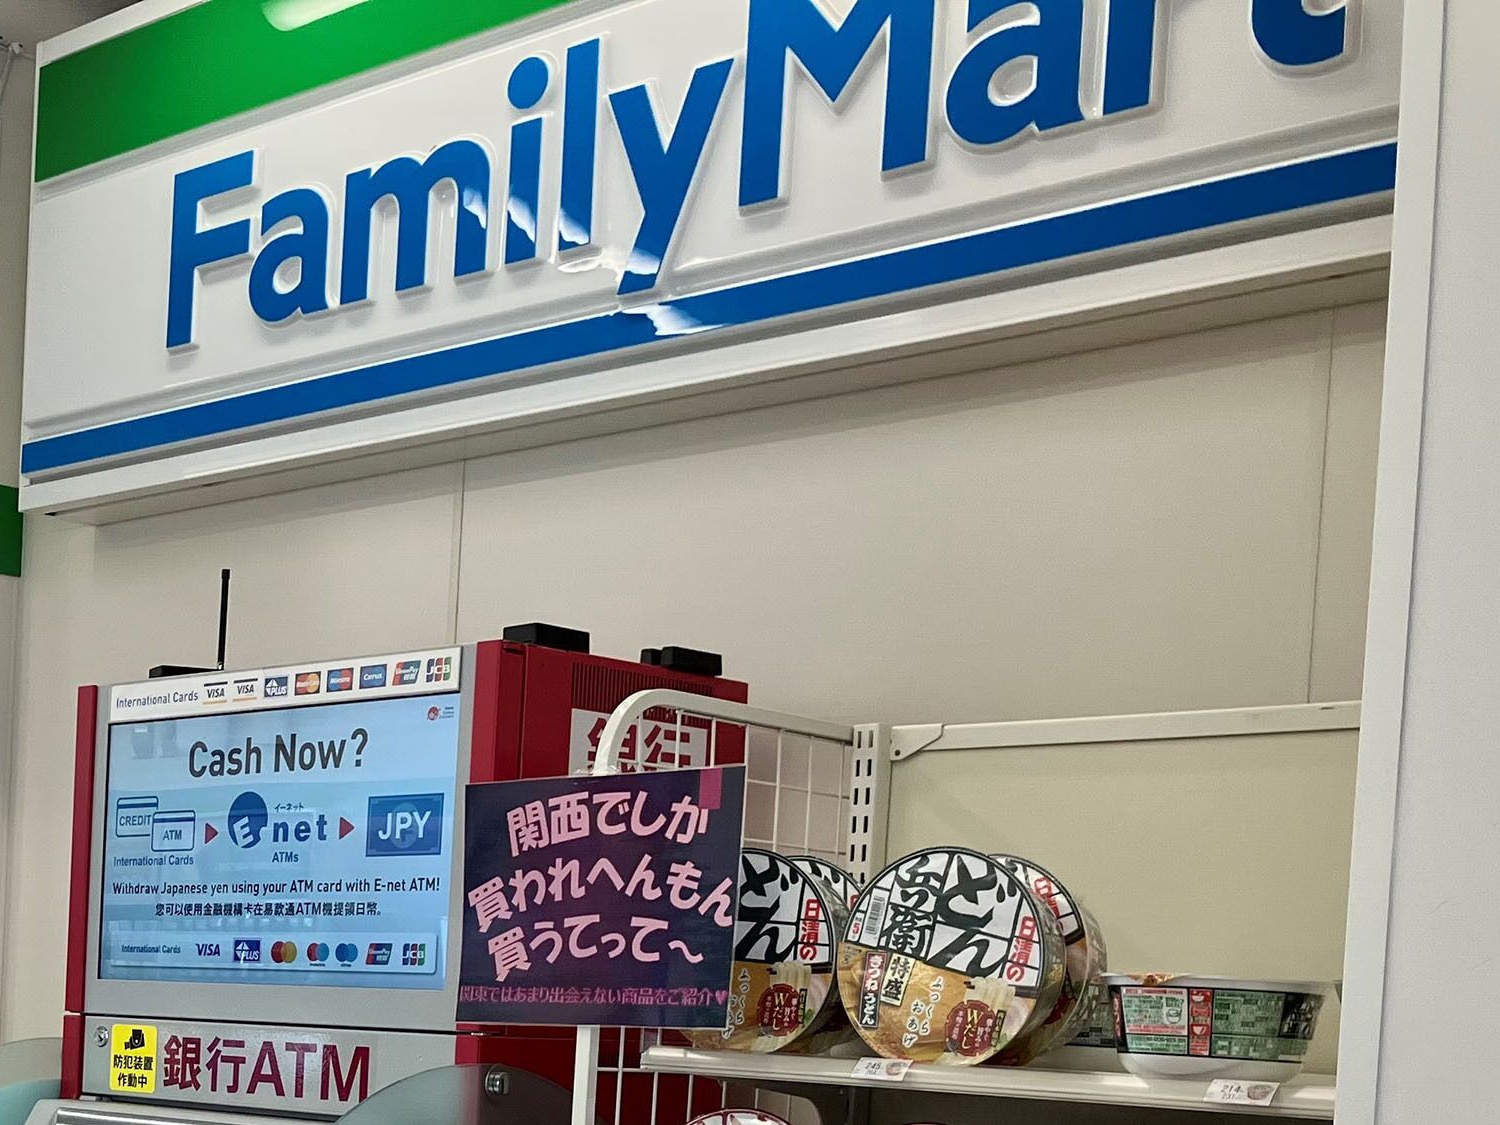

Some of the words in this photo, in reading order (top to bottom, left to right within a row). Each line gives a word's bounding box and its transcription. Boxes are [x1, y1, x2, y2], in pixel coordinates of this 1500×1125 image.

[166, 0, 1346, 350] FamilyMar
[116, 692, 170, 709] International
[173, 690, 199, 704] Cards
[206, 686, 225, 699] VISA
[237, 684, 255, 696] VISA
[271, 685, 288, 697] PLUS
[363, 672, 383, 681] Cirrus
[426, 662, 451, 677] JCB
[188, 737, 262, 778] Cash
[274, 727, 369, 773] Now?
[119, 814, 151, 827] CREDIT
[273, 814, 327, 843] net
[378, 810, 431, 841] JPY
[162, 828, 183, 842] ATM
[507, 791, 708, 857] 関西でしか
[113, 854, 168, 867] International
[169, 853, 194, 866] Cards
[272, 851, 299, 863] ATMs
[113, 881, 159, 896] Withdraw
[161, 881, 209, 897] Japanese
[211, 884, 229, 897] yen
[231, 880, 259, 896] using
[262, 882, 287, 896] your
[290, 880, 313, 893] ATM
[317, 879, 343, 893] card
[346, 878, 371, 892] with
[374, 878, 407, 892] E-net
[409, 877, 441, 892] ATM!
[467, 854, 733, 933] 買われへんもん
[121, 943, 159, 954] International
[161, 944, 181, 955] Cards
[196, 942, 221, 957] VISA
[243, 949, 261, 962] PLUS
[402, 946, 425, 962] JCB
[884, 955, 912, 1004] 特盛
[113, 1054, 153, 1072] 防犯装置
[117, 1073, 148, 1089] 作動中
[163, 1034, 371, 1104] 銀行ATM
